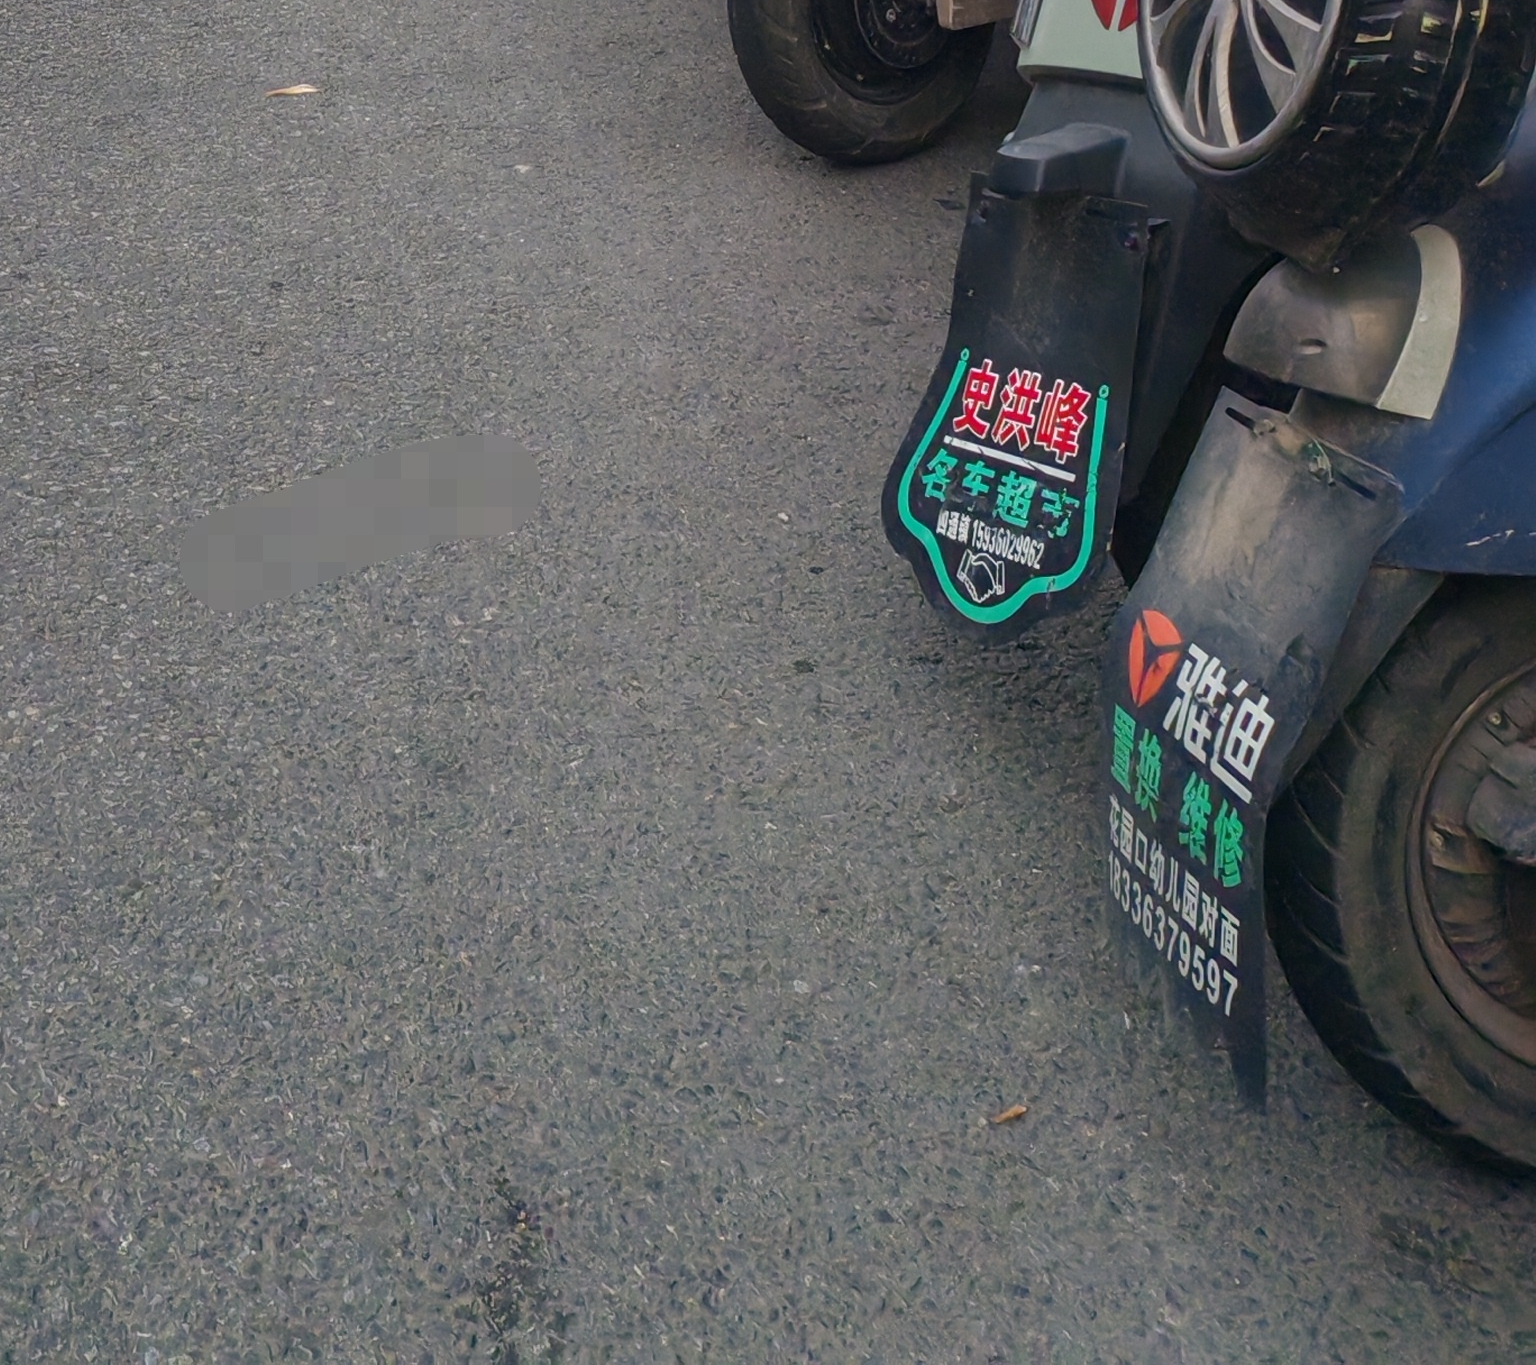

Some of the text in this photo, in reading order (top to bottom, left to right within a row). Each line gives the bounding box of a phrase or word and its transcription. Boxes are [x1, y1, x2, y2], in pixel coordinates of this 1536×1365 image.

[953, 359, 1091, 464] 史洪峰
[972, 520, 1045, 569] 15936029962
[1111, 703, 1244, 888] 置换 维修
[1164, 643, 1275, 804] 雅迪
[1108, 854, 1238, 1016] 18336379597
[1109, 795, 1240, 967] 花园口幼儿园对面
